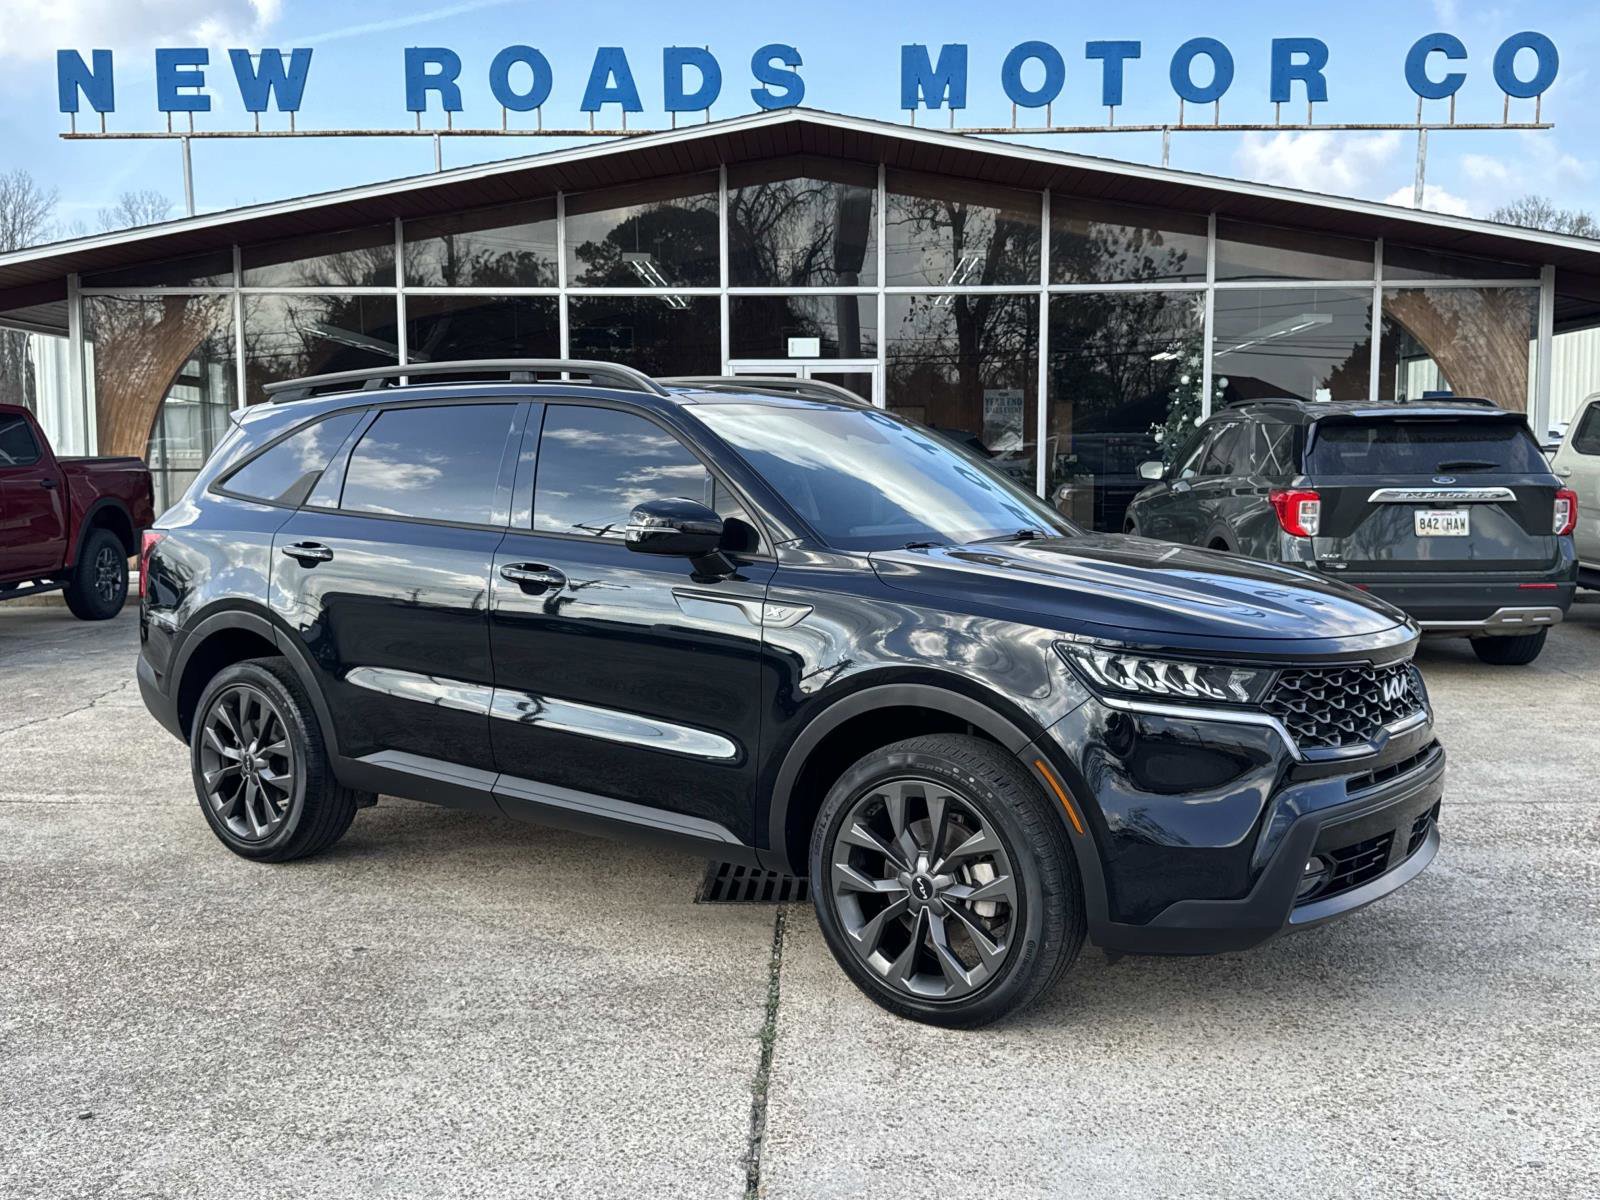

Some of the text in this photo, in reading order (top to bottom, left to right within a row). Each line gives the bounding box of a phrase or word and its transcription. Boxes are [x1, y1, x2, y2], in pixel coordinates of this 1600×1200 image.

[57, 31, 1559, 113] NEW ROADS MOTOR CO
[1006, 397, 1023, 407] END
[1419, 517, 1466, 530] 842 HAW
